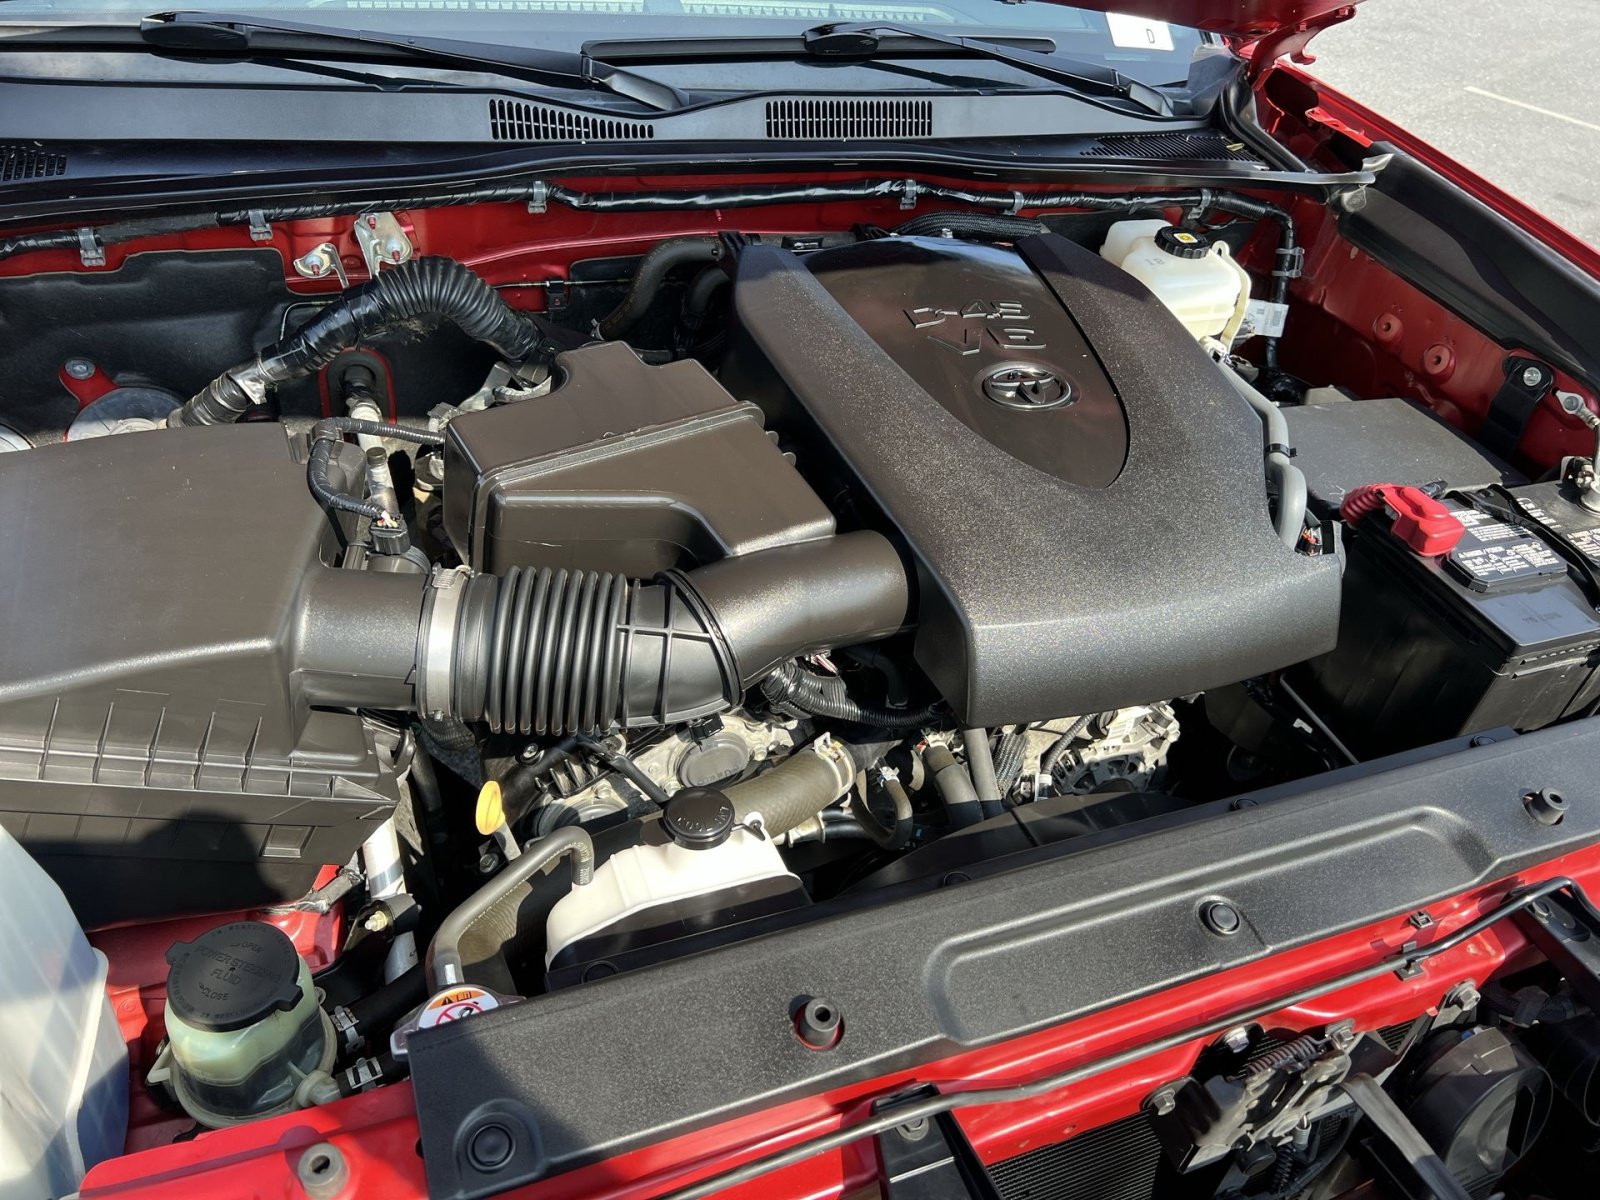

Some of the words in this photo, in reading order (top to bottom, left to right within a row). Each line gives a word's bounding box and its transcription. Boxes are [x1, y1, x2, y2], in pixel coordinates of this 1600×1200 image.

[1145, 28, 1156, 44] D
[926, 325, 1047, 356] V6
[195, 946, 232, 964] POWER
[241, 941, 263, 953] OPEN
[210, 968, 241, 986] FLUID
[202, 987, 231, 1001] CLOSE
